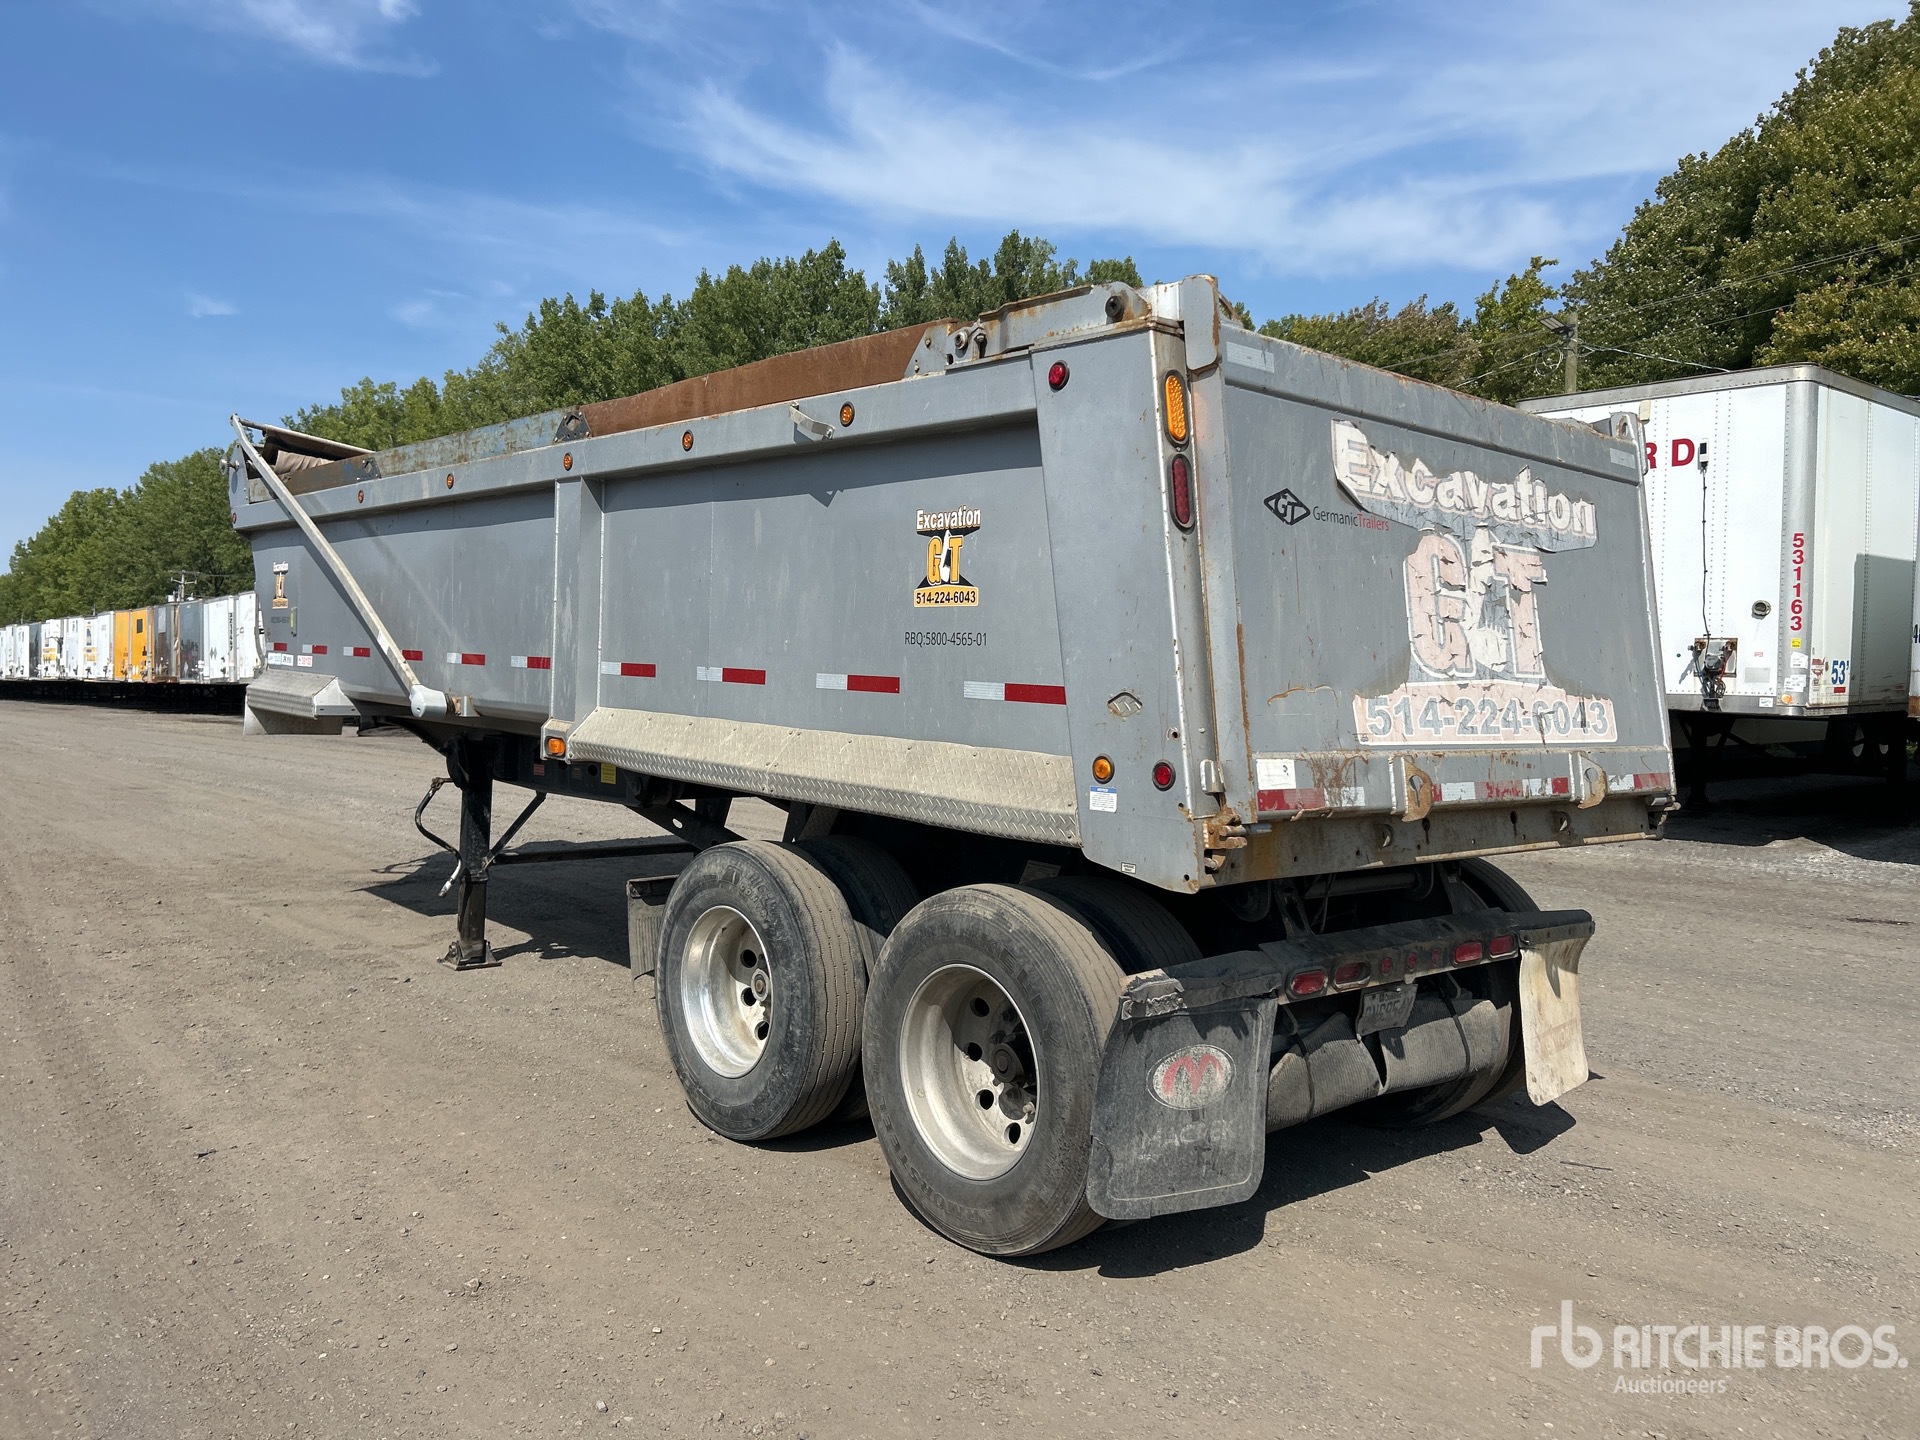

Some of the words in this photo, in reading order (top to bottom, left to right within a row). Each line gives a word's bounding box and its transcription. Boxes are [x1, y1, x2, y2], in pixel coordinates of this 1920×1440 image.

[1333, 420, 1597, 537] Excavation
[916, 504, 981, 531] Excavation
[927, 535, 964, 585] GT
[1789, 533, 1805, 631] 531163
[916, 590, 976, 604] 514-224-6043
[1403, 534, 1548, 679] GT
[1366, 695, 1610, 737] 514-224-6043
